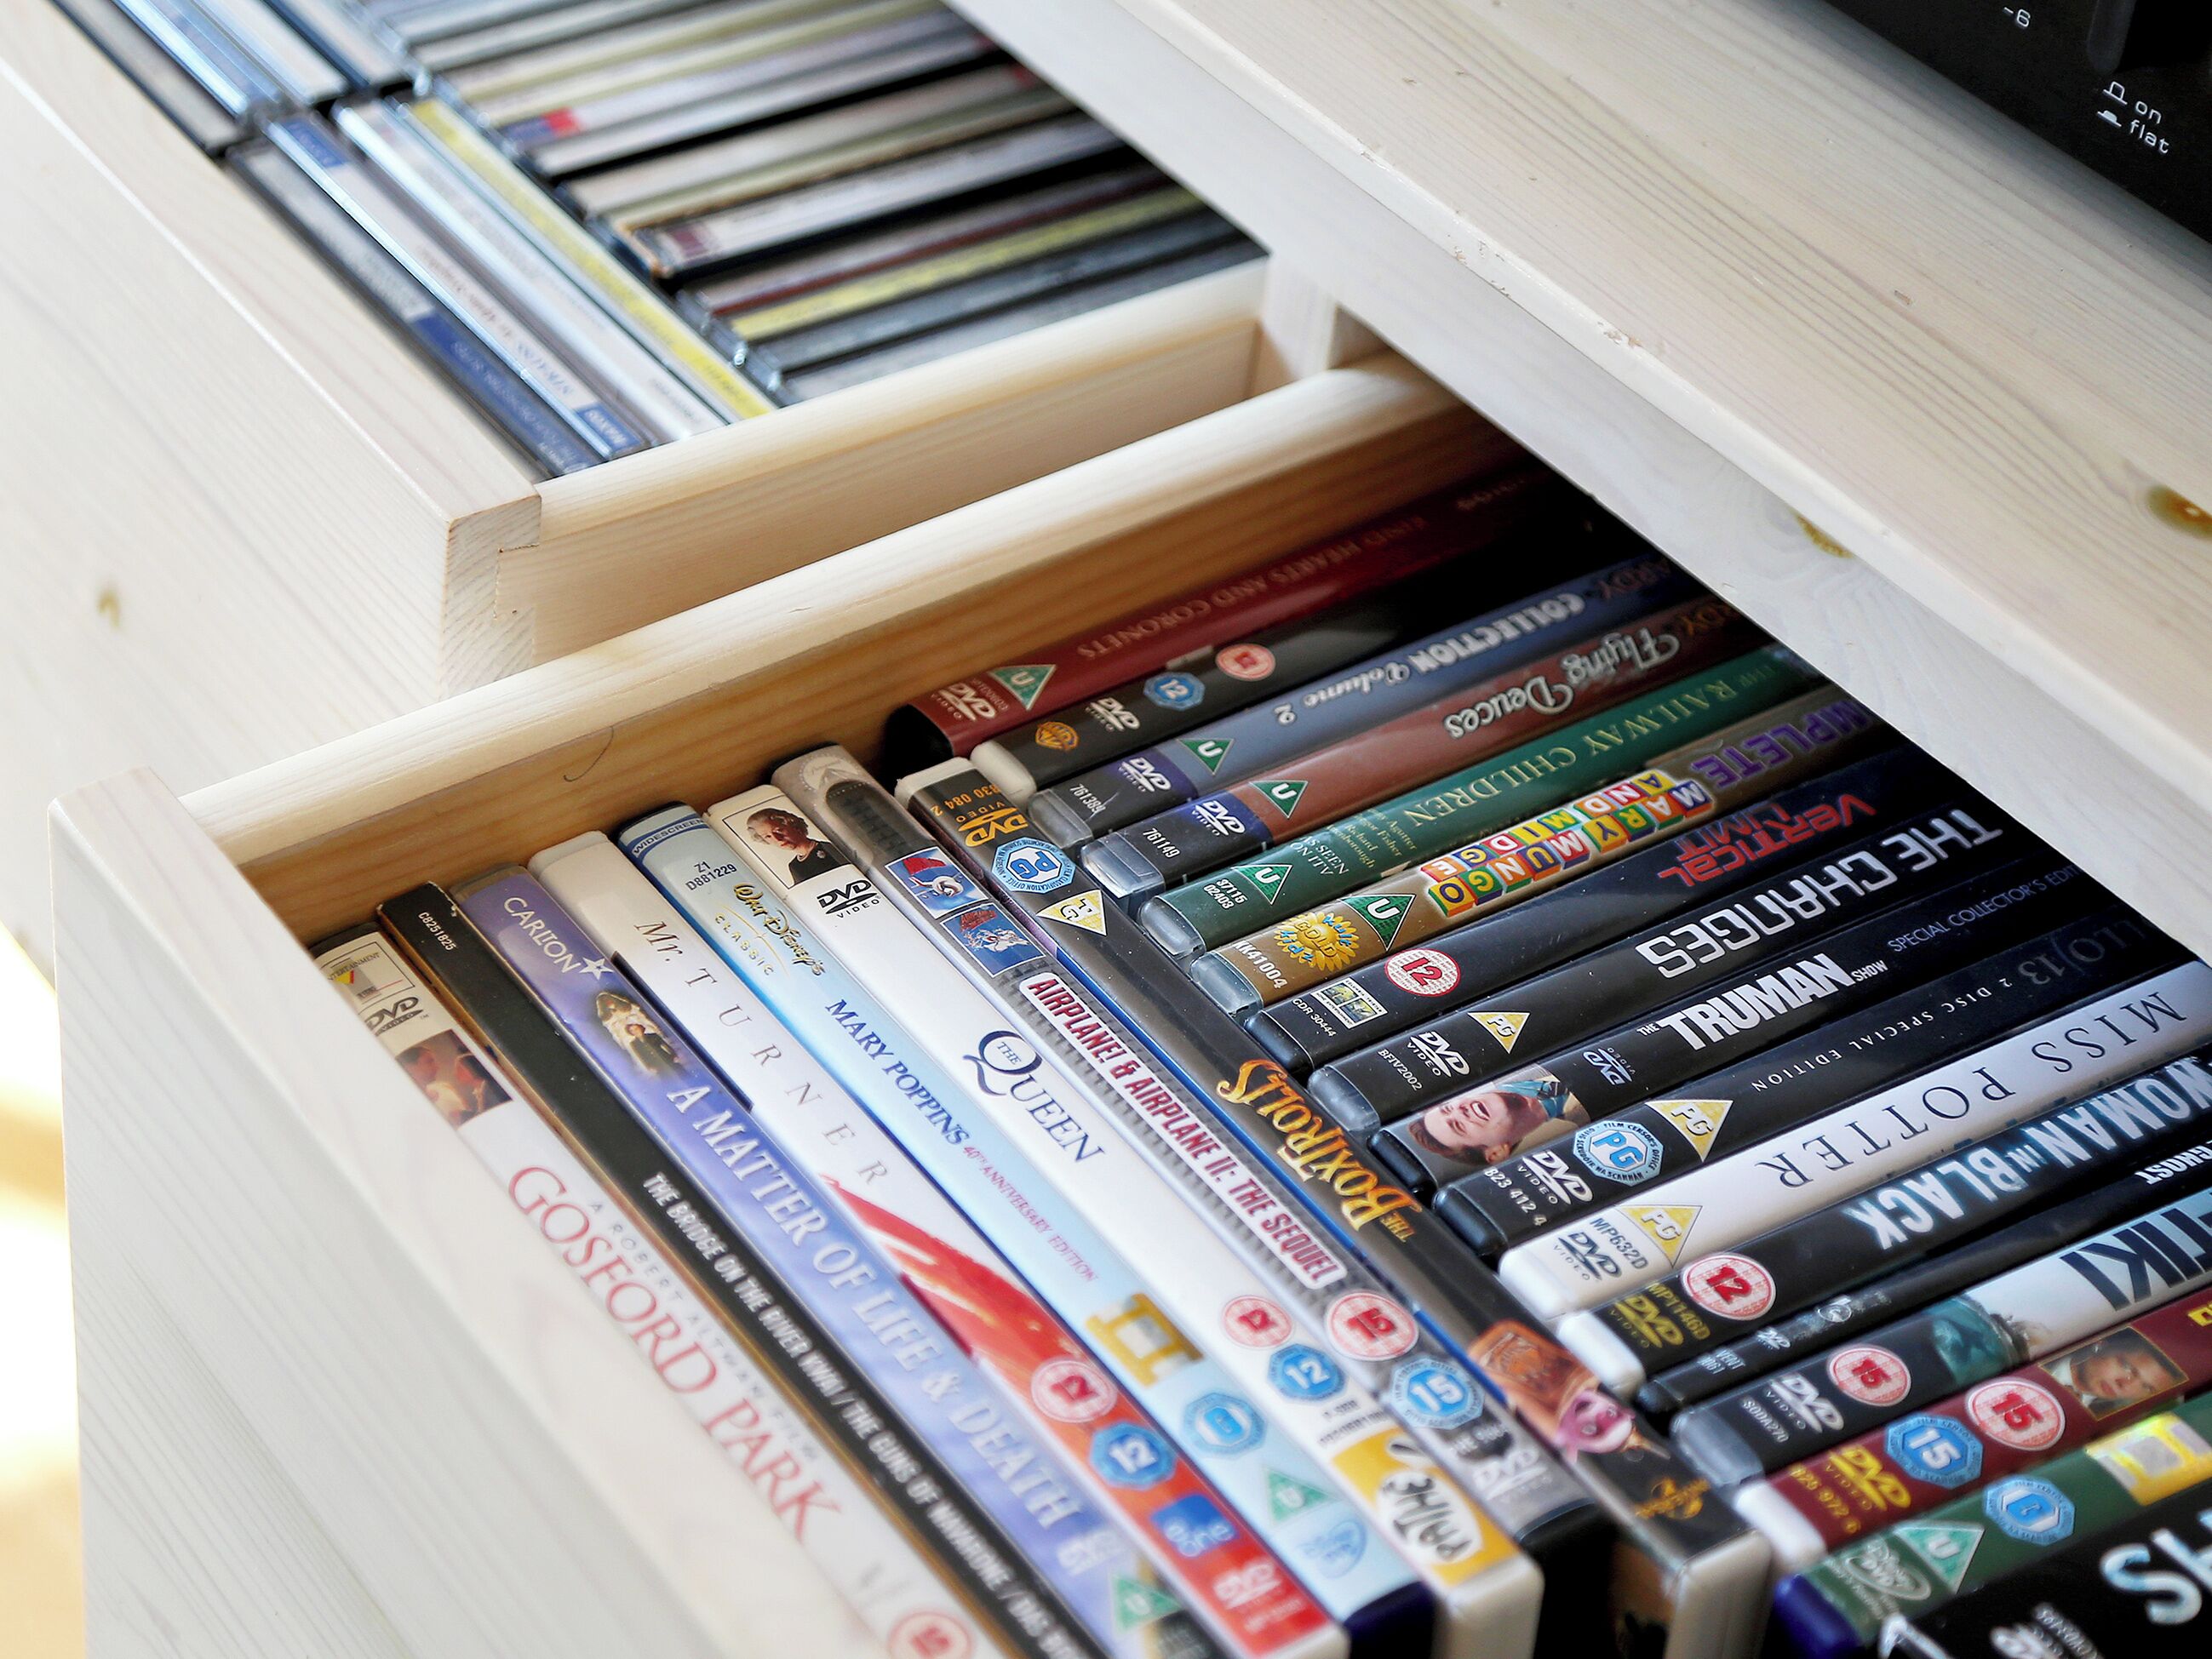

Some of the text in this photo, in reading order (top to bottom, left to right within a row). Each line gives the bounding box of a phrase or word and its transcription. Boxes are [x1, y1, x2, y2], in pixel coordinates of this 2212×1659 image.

[2003, 6, 2031, 28] -6
[2134, 100, 2163, 124] on
[2129, 119, 2169, 154] flat
[1077, 599, 1212, 660] CORONETS
[1275, 592, 1585, 725] COLLECTION Volume 2
[1010, 671, 1035, 686] U
[1161, 678, 1189, 698] 12
[1442, 626, 1681, 740] Flying Deuces
[947, 683, 996, 720] DVD
[1098, 696, 1140, 730] DVD
[1197, 741, 1223, 758] U
[1402, 678, 1739, 829] RAILWAY CHILDREN
[1131, 756, 1172, 792] DVD
[1271, 782, 1298, 802] U
[944, 791, 971, 810] 084
[956, 801, 1006, 824] VIDEO
[1203, 798, 1246, 836] DVD
[631, 817, 705, 855] WIDESCREEN
[964, 814, 1029, 848] DVD
[1192, 809, 1220, 837] VIDEO
[1378, 829, 1403, 856] Fisher
[1389, 820, 1418, 850] Agutter
[1430, 774, 1665, 878] AND MIDGE
[1676, 801, 1791, 852] LIMIT
[1143, 827, 1181, 859] 761149
[1290, 841, 1334, 876] ON ITV
[1315, 844, 1350, 875] SEEN
[1439, 781, 1709, 906] MARY MUNGO
[685, 862, 738, 892] D881229
[693, 861, 713, 875] Z1
[1010, 850, 1058, 879] PG
[1255, 867, 1281, 885] U
[817, 878, 873, 909] DVD
[836, 898, 880, 919] VIDEO
[1060, 898, 1099, 922] PG
[1202, 884, 1235, 911] 02403
[1215, 878, 1248, 904] 37115
[1367, 896, 1395, 921] U
[1635, 808, 2004, 980] THE CHANGES
[417, 911, 458, 952] C8251825
[1886, 877, 2049, 952] SPECIAL COLLECTOR'S
[503, 896, 582, 974] CARLTON
[633, 919, 684, 964] Mr.
[714, 912, 775, 976] CLASSIC
[1294, 920, 1338, 958] GOLD
[1231, 939, 1288, 990] KK41004
[1401, 957, 1442, 987] 12
[2017, 951, 2066, 986] 13
[1027, 977, 1131, 1065] AIRPLANE!
[1291, 996, 1338, 1038] CDR 30444
[1636, 952, 1890, 1053] THE TRUMAN SHOW
[1485, 1015, 1517, 1040] PG
[1751, 977, 2013, 1094] 2 DISC SPECIAL EDITION
[995, 1040, 1023, 1067] THE
[1109, 1058, 1141, 1081] &
[1377, 1047, 1424, 1092] BFIV2002
[1406, 1041, 1444, 1078] VIDEO
[1421, 1030, 1470, 1078] DVD
[1584, 1050, 1633, 1086] DVD
[962, 1030, 1106, 1163] QUEEN
[1754, 991, 2188, 1190] MISS POTTER
[1123, 1074, 1223, 1160] AIRPLANE
[1670, 1102, 1716, 1138] PG
[823, 998, 1098, 1283] MARY POPPINS ANNIVERSARY EDITION
[1215, 1059, 1424, 1244] THE BOXTROLLS
[1591, 1130, 1644, 1170] PG
[1842, 1055, 2212, 1251] WOMAN IN BLACK
[1516, 1162, 1559, 1206] VIDEO
[1532, 1149, 1594, 1204] DVD
[1228, 1177, 1278, 1217] THE
[1510, 1188, 1550, 1227] 412 4
[1589, 1217, 1649, 1270] MP632D
[1640, 1211, 1682, 1241] PG
[1260, 1210, 1340, 1282] SEQUEL
[1552, 1243, 1591, 1282] VIDEO
[1567, 1231, 1622, 1279] DVD
[1705, 1266, 1753, 1305] 12
[666, 1084, 1082, 1530] A MATTER OF LIFE & DEATH
[1347, 1307, 1398, 1342] 15
[1622, 1294, 1685, 1347] DVD
[1607, 1309, 1651, 1350] VIDEO
[507, 1165, 845, 1544] GOSFORD PARK
[1850, 1356, 1892, 1391] 15
[641, 1171, 1017, 1593] THE BRIDGE ON THE RIVER KWAI THE GUNS OF NAVARONE
[1286, 1359, 1330, 1390] 12
[1408, 1374, 1465, 1406] 15
[1764, 1387, 1807, 1432] VIDEO
[1779, 1372, 1846, 1432] DVD
[1991, 1390, 2043, 1431] 15
[1108, 1438, 1159, 1475] 12
[1906, 1427, 1963, 1471] 15
[1825, 1462, 1873, 1511] VIDEO
[1839, 1444, 1911, 1510] DVD
